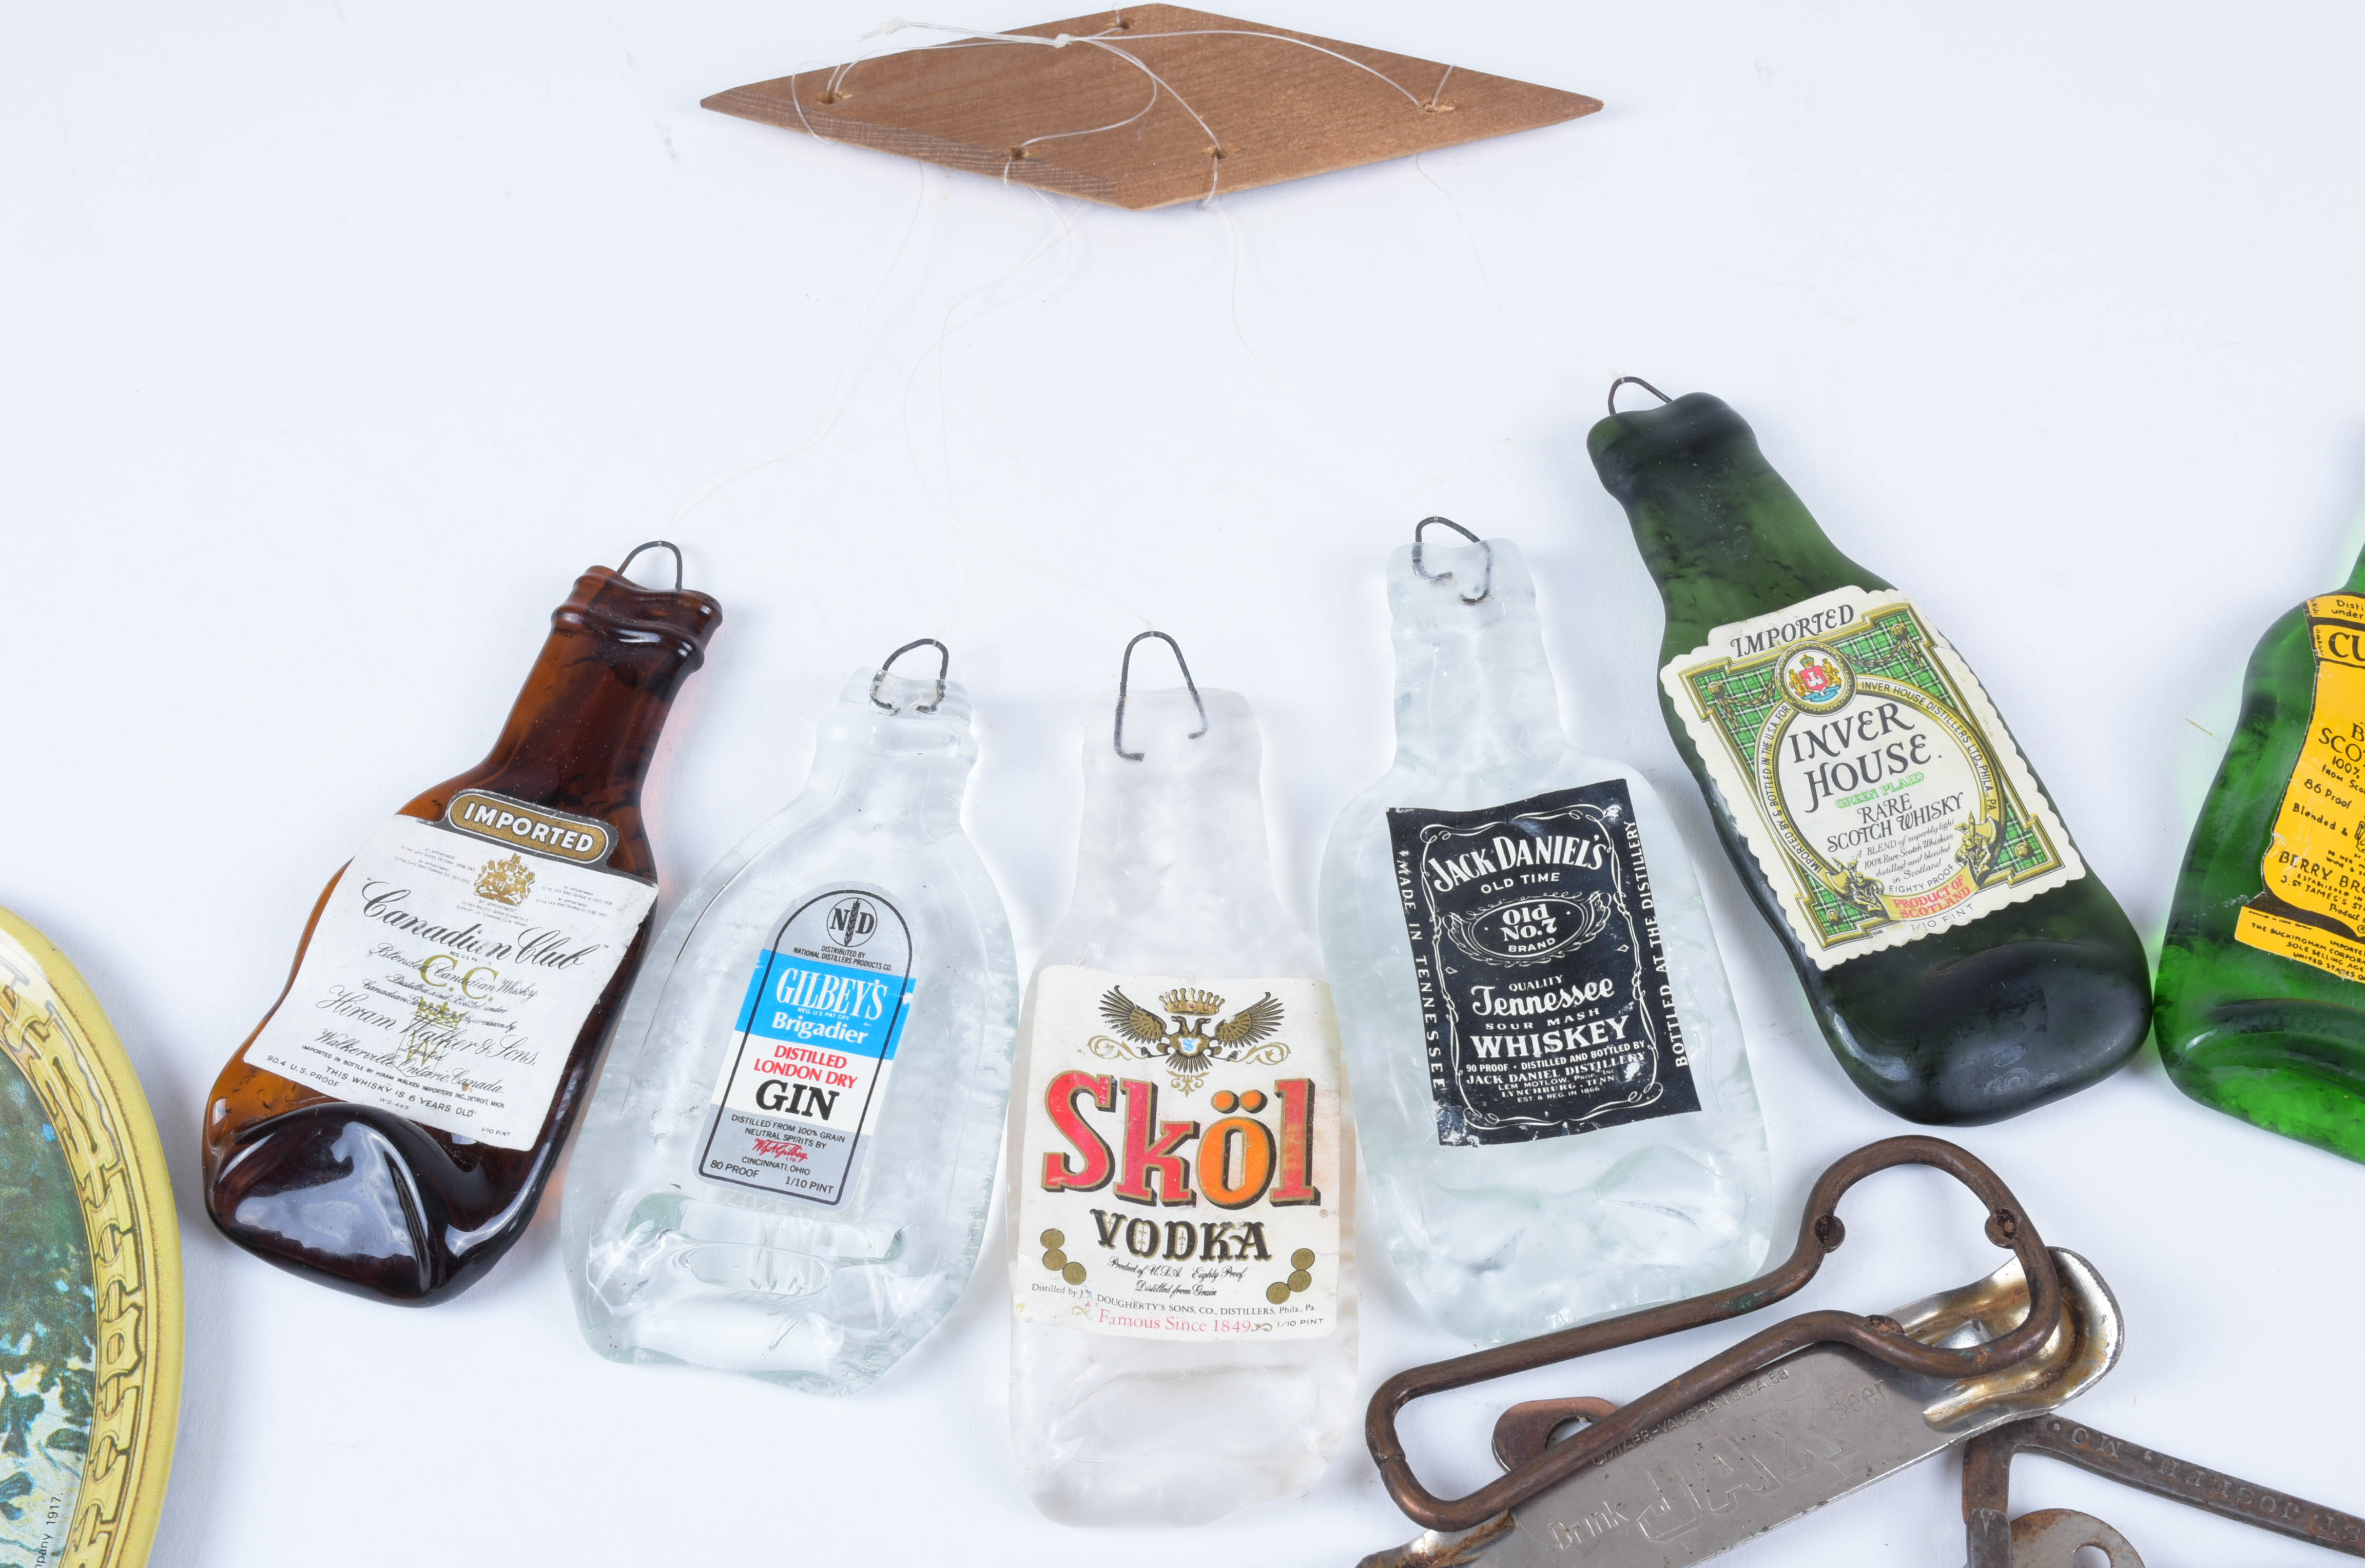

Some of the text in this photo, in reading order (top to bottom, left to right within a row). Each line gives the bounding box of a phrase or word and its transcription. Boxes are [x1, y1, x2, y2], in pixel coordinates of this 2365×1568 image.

[2332, 610, 2363, 619] under
[1730, 604, 1855, 658] IMPORTED
[1861, 681, 1972, 743] INVER HOUSE DISTILLERS
[1788, 703, 1915, 763] INVER
[2332, 756, 2364, 779] 100%
[1761, 705, 1822, 873] IMPORTED BY BOTTLED IN THE FOR
[1837, 772, 1924, 808] GREEN PLAID
[2304, 779, 2352, 809] 86 Proof
[1828, 792, 1963, 852] SCOTCH WHISKY
[1857, 793, 1912, 824] RARE
[2293, 803, 2336, 830] Blended
[464, 803, 595, 851] IMPORTED
[1867, 819, 1954, 855] BLEND of light
[1427, 834, 1607, 894] JACK DANIEL'S
[1865, 834, 1953, 869] 100% Rare Scotch Whiskies
[1876, 844, 1950, 877] distilled and blended
[2279, 851, 2333, 880] BERRY
[1481, 873, 1560, 893] OLD TIME
[1887, 864, 1955, 894] EIGHTY PROOF
[1904, 858, 1941, 879] Scotland
[1893, 875, 1963, 914] PRODUCT OF
[1901, 886, 1971, 918] SCOTLAND
[1503, 904, 1549, 925] Old
[822, 946, 857, 957] DISTRIBUTED
[1508, 938, 1557, 956] BRAND
[1623, 820, 1688, 1068] BOTTLED AT THE DISTILLERY
[2252, 923, 2326, 950] THE BUCKINGHAM
[793, 948, 819, 958] NATIONAL
[822, 953, 852, 964] DISTILLERS
[853, 959, 882, 969] PRODUCTS
[2286, 942, 2344, 965] SOLE SELLING
[2293, 952, 2322, 965] UNITED
[1397, 860, 1446, 1089] MADE IN TENNESSEE
[1509, 975, 1562, 991] QUALITY
[318, 985, 398, 1030] Hiram
[776, 967, 887, 1021] GILBEY'S
[1471, 977, 1615, 1016] Tennessee
[772, 1012, 868, 1044] Brigadier
[1547, 1008, 1599, 1026] MASH
[1469, 1014, 1630, 1059] WHISKEY
[267, 1055, 339, 1086] 90.4 U.S. PROOF
[302, 1046, 332, 1059] IMPORTED
[343, 1060, 364, 1070] BOTTLE
[398, 1078, 419, 1088] WALKER
[422, 1086, 453, 1096] IMPORTERS
[774, 1045, 847, 1068] DISTILLED
[1480, 1064, 1508, 1072] PROOF
[1521, 1057, 1566, 1070] DISTILLED
[1570, 1053, 1587, 1063] AND
[1591, 1044, 1630, 1058] BOTTLED
[1633, 1041, 1644, 1049] BY
[754, 1059, 858, 1088] LONDON DRY
[1466, 1071, 1503, 1084] JACK
[1509, 1069, 1560, 1082] DANIEL
[327, 1067, 348, 1080] THIS
[353, 1077, 392, 1092] WHISKY
[421, 1097, 451, 1111] YEARS
[456, 1108, 473, 1116] OLD
[380, 1097, 409, 1109] WG-495
[756, 1080, 840, 1121] GIN
[1502, 1084, 1575, 1097] LYNCHBURG
[731, 1114, 845, 1142] DISTILLED FROM 100% GRAIN
[745, 1128, 780, 1140] NEUTRAL
[783, 1134, 813, 1146] SPIRITS
[1041, 1069, 1321, 1210] Sköl
[710, 1160, 760, 1177] 80 PROOF
[790, 1165, 810, 1175] OHIO
[786, 1177, 833, 1193] 1/10 PINT
[1089, 1209, 1273, 1263] VODKA
[1108, 1258, 1246, 1281] Product Proof
[1032, 1284, 1065, 1293] Distilled
[1069, 1287, 1077, 1297] by
[1097, 1294, 1165, 1310] DOUGHERTY'S
[1170, 1305, 1195, 1314] SONS,
[1136, 1280, 1217, 1298] Distilled from Grain
[1099, 1309, 1251, 1333] Famous Since 1849
[1829, 1378, 1887, 1421] Beer
[46, 1492, 64, 1525] 1917.
[1549, 1500, 1630, 1550] Drink
